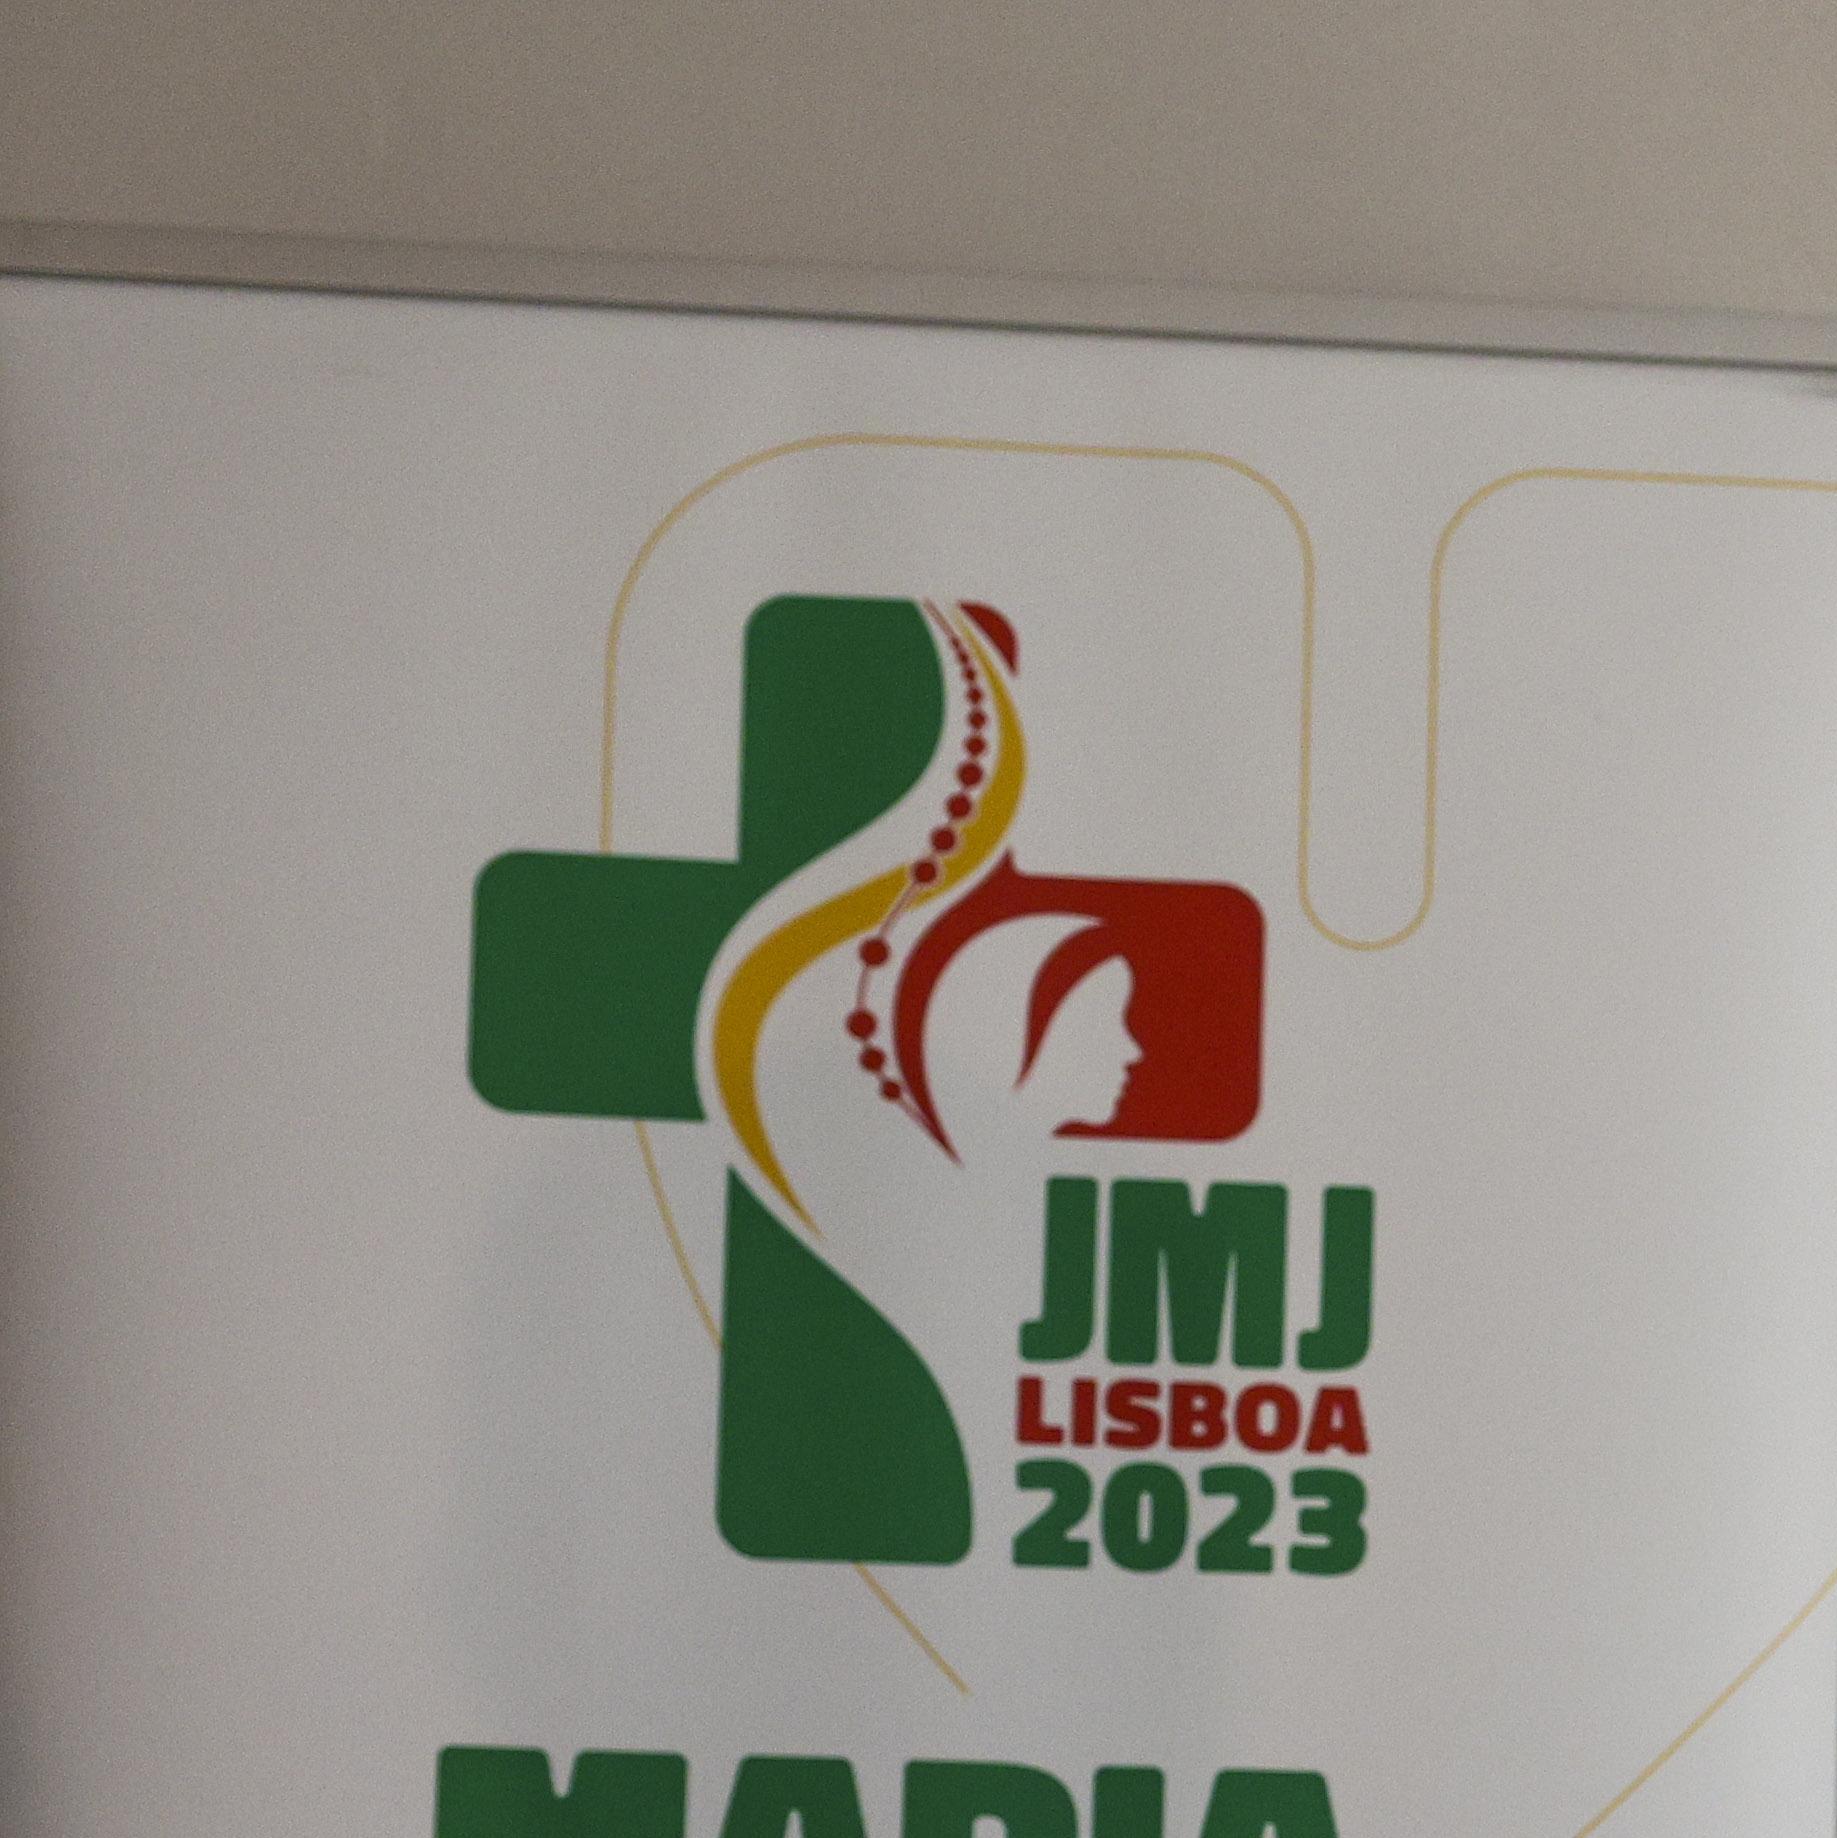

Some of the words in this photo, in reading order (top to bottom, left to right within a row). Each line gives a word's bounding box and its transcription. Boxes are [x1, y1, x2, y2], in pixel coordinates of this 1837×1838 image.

[1017, 1175, 1376, 1372] JMJ
[1014, 1376, 1370, 1456] LISBOA
[1011, 1459, 1369, 1578] 2023
